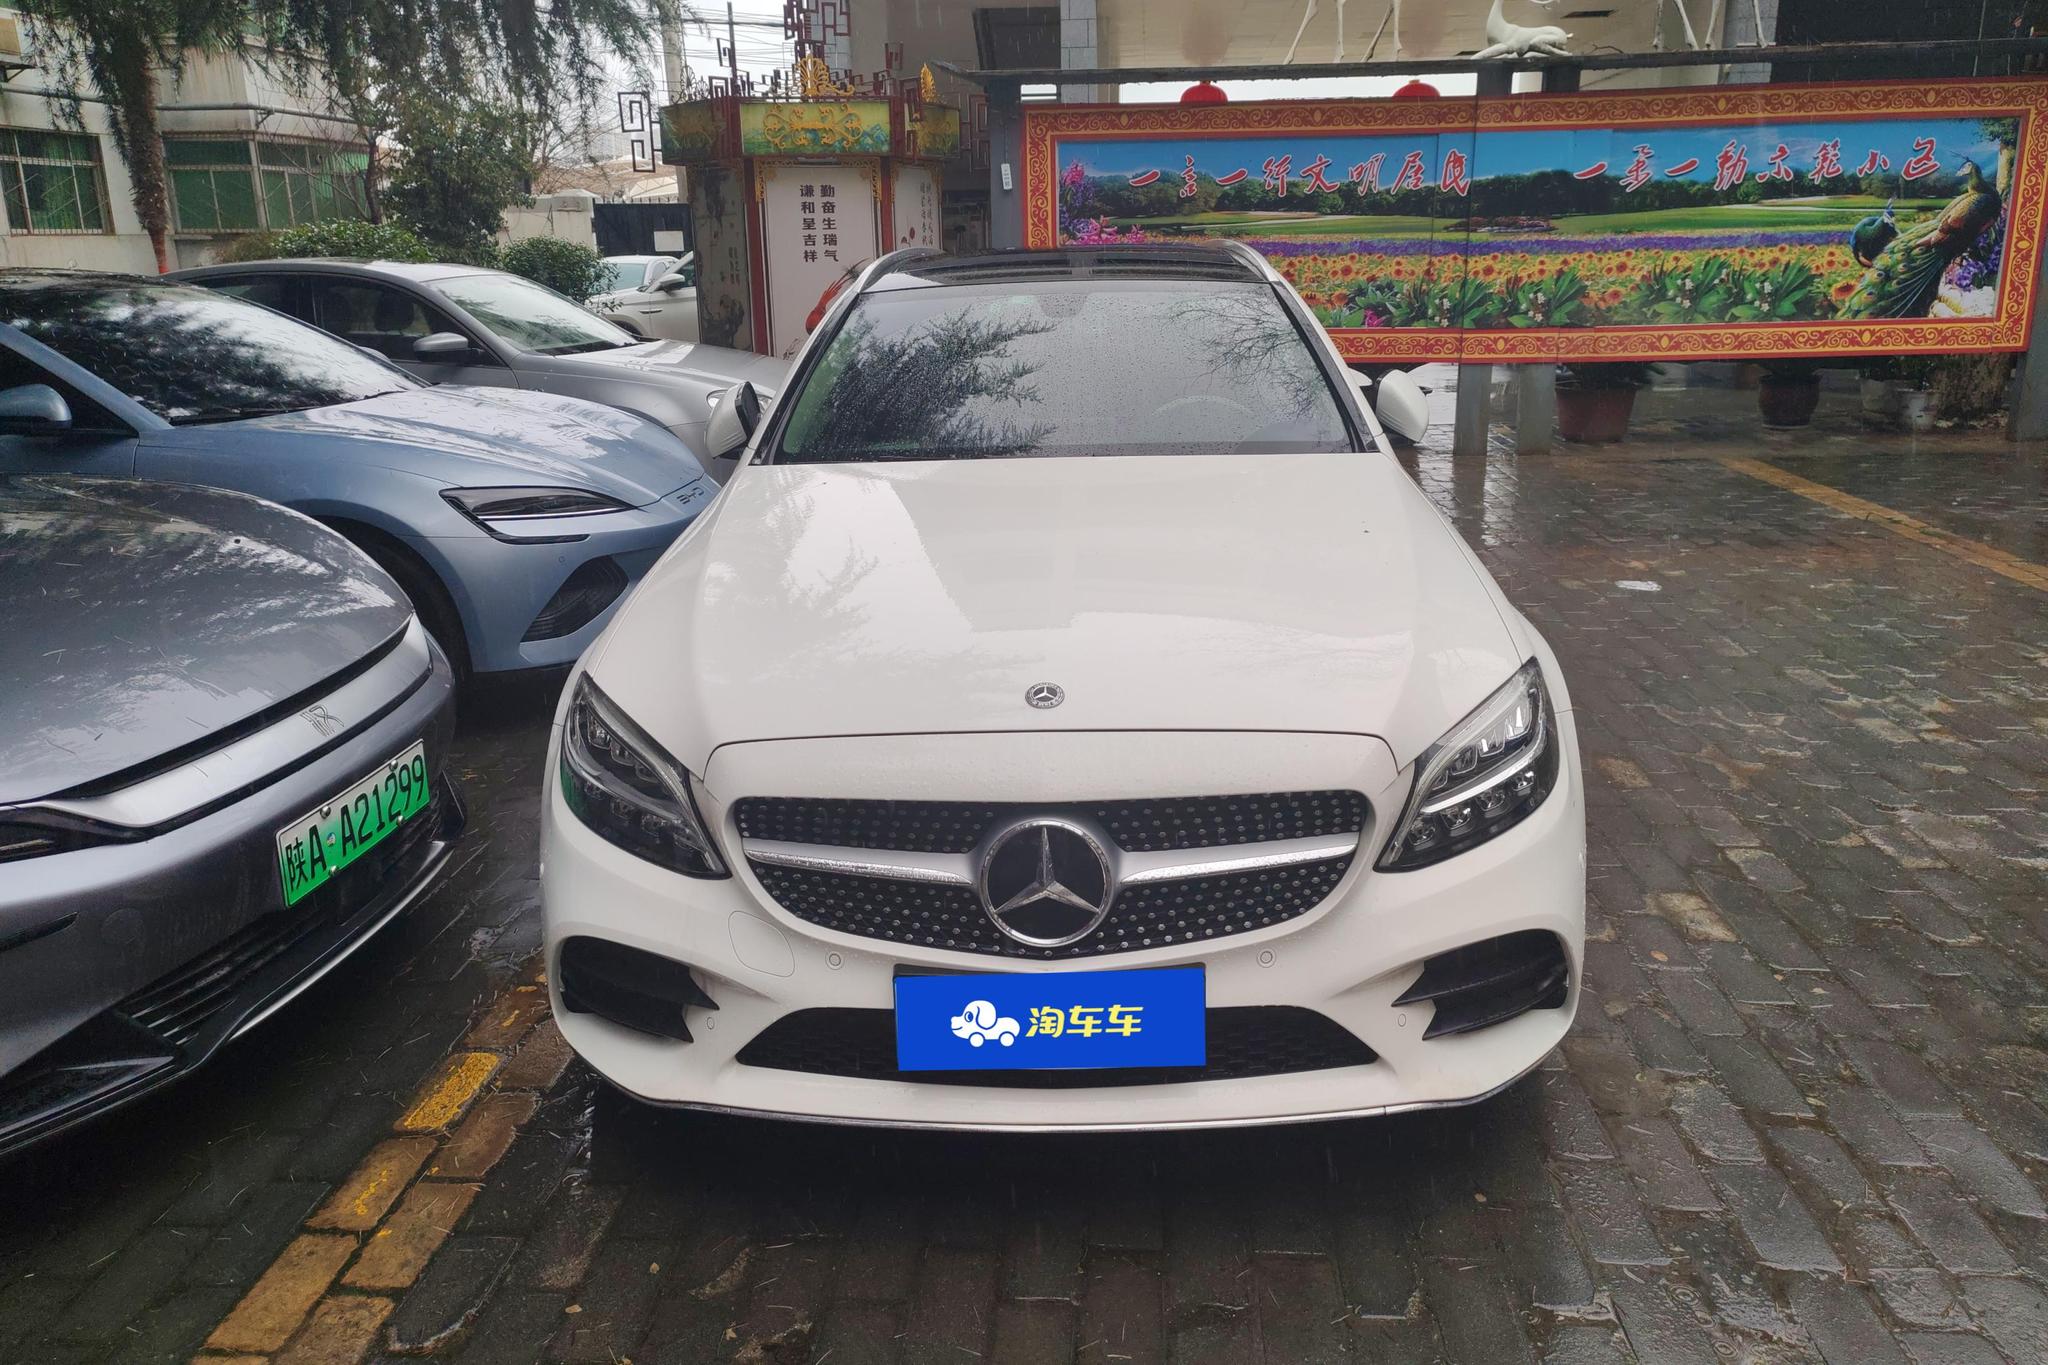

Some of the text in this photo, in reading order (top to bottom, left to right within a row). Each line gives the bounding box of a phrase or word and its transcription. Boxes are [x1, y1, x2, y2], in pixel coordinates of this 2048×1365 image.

[820, 184, 839, 262] 勤奋生瑞气
